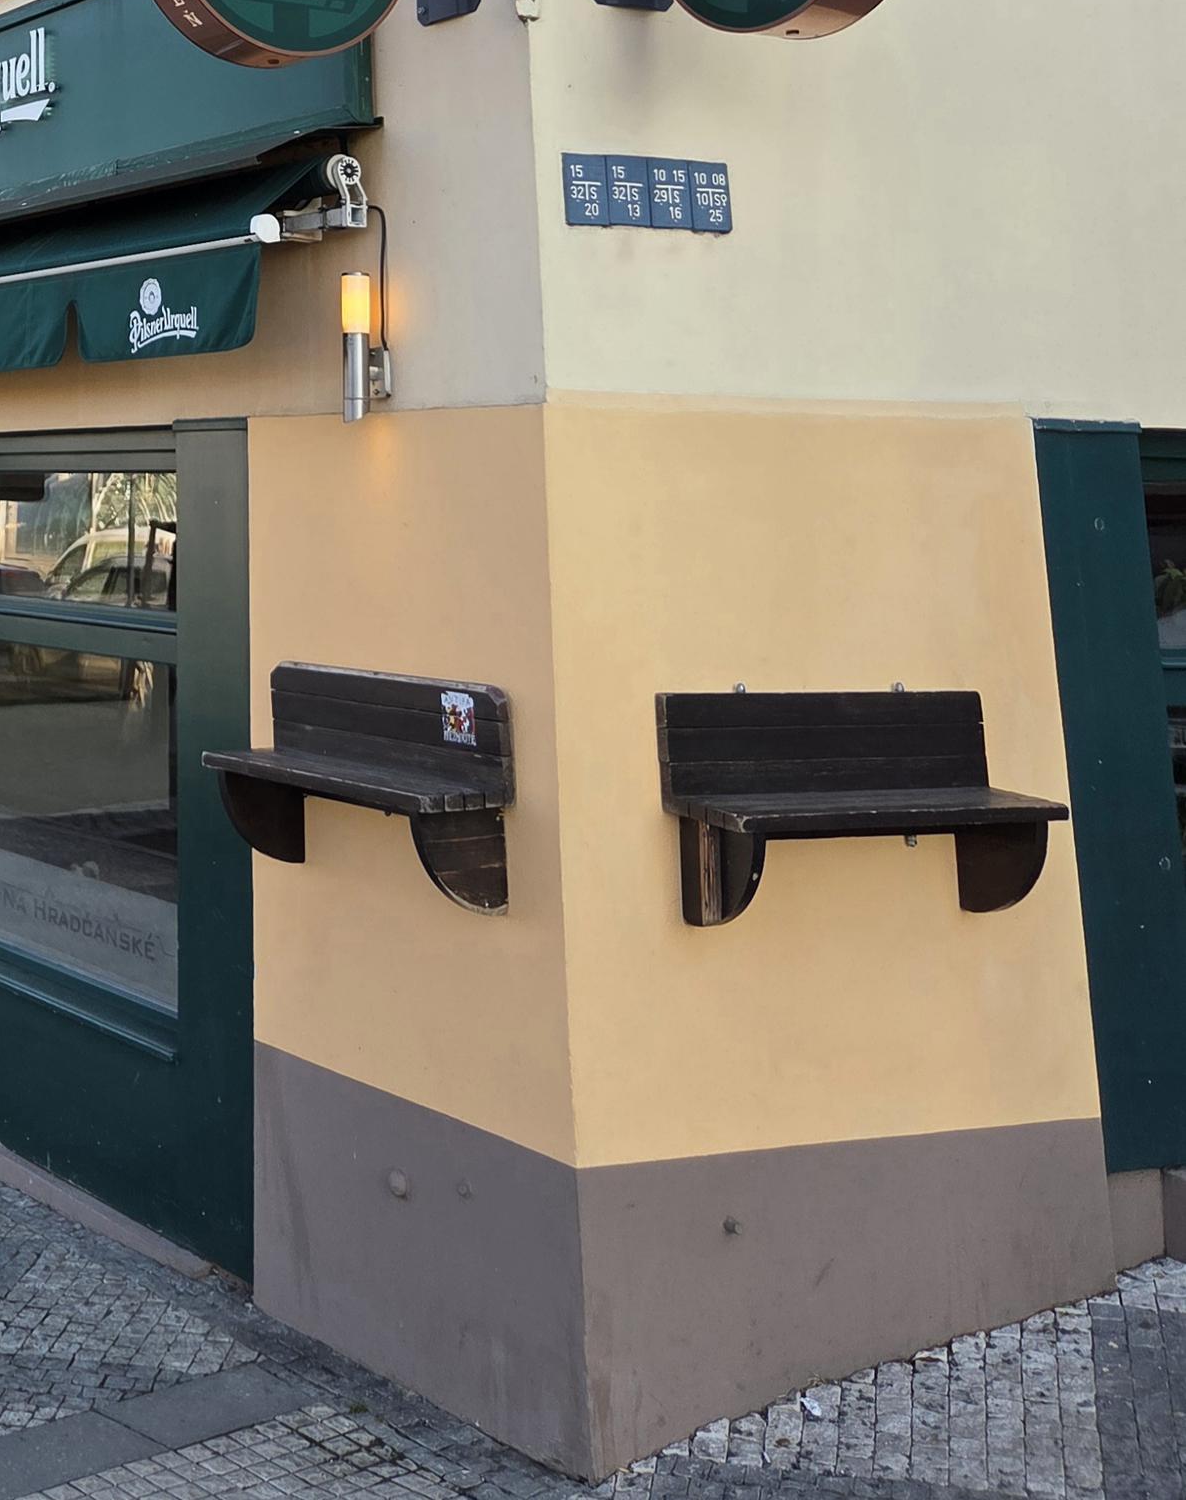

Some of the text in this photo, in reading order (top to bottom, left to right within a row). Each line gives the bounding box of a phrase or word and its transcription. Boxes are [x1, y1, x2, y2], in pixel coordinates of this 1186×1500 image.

[570, 164, 583, 178] 15
[611, 165, 625, 179] 15
[33, 898, 156, 961] HRADČANSKÉ
